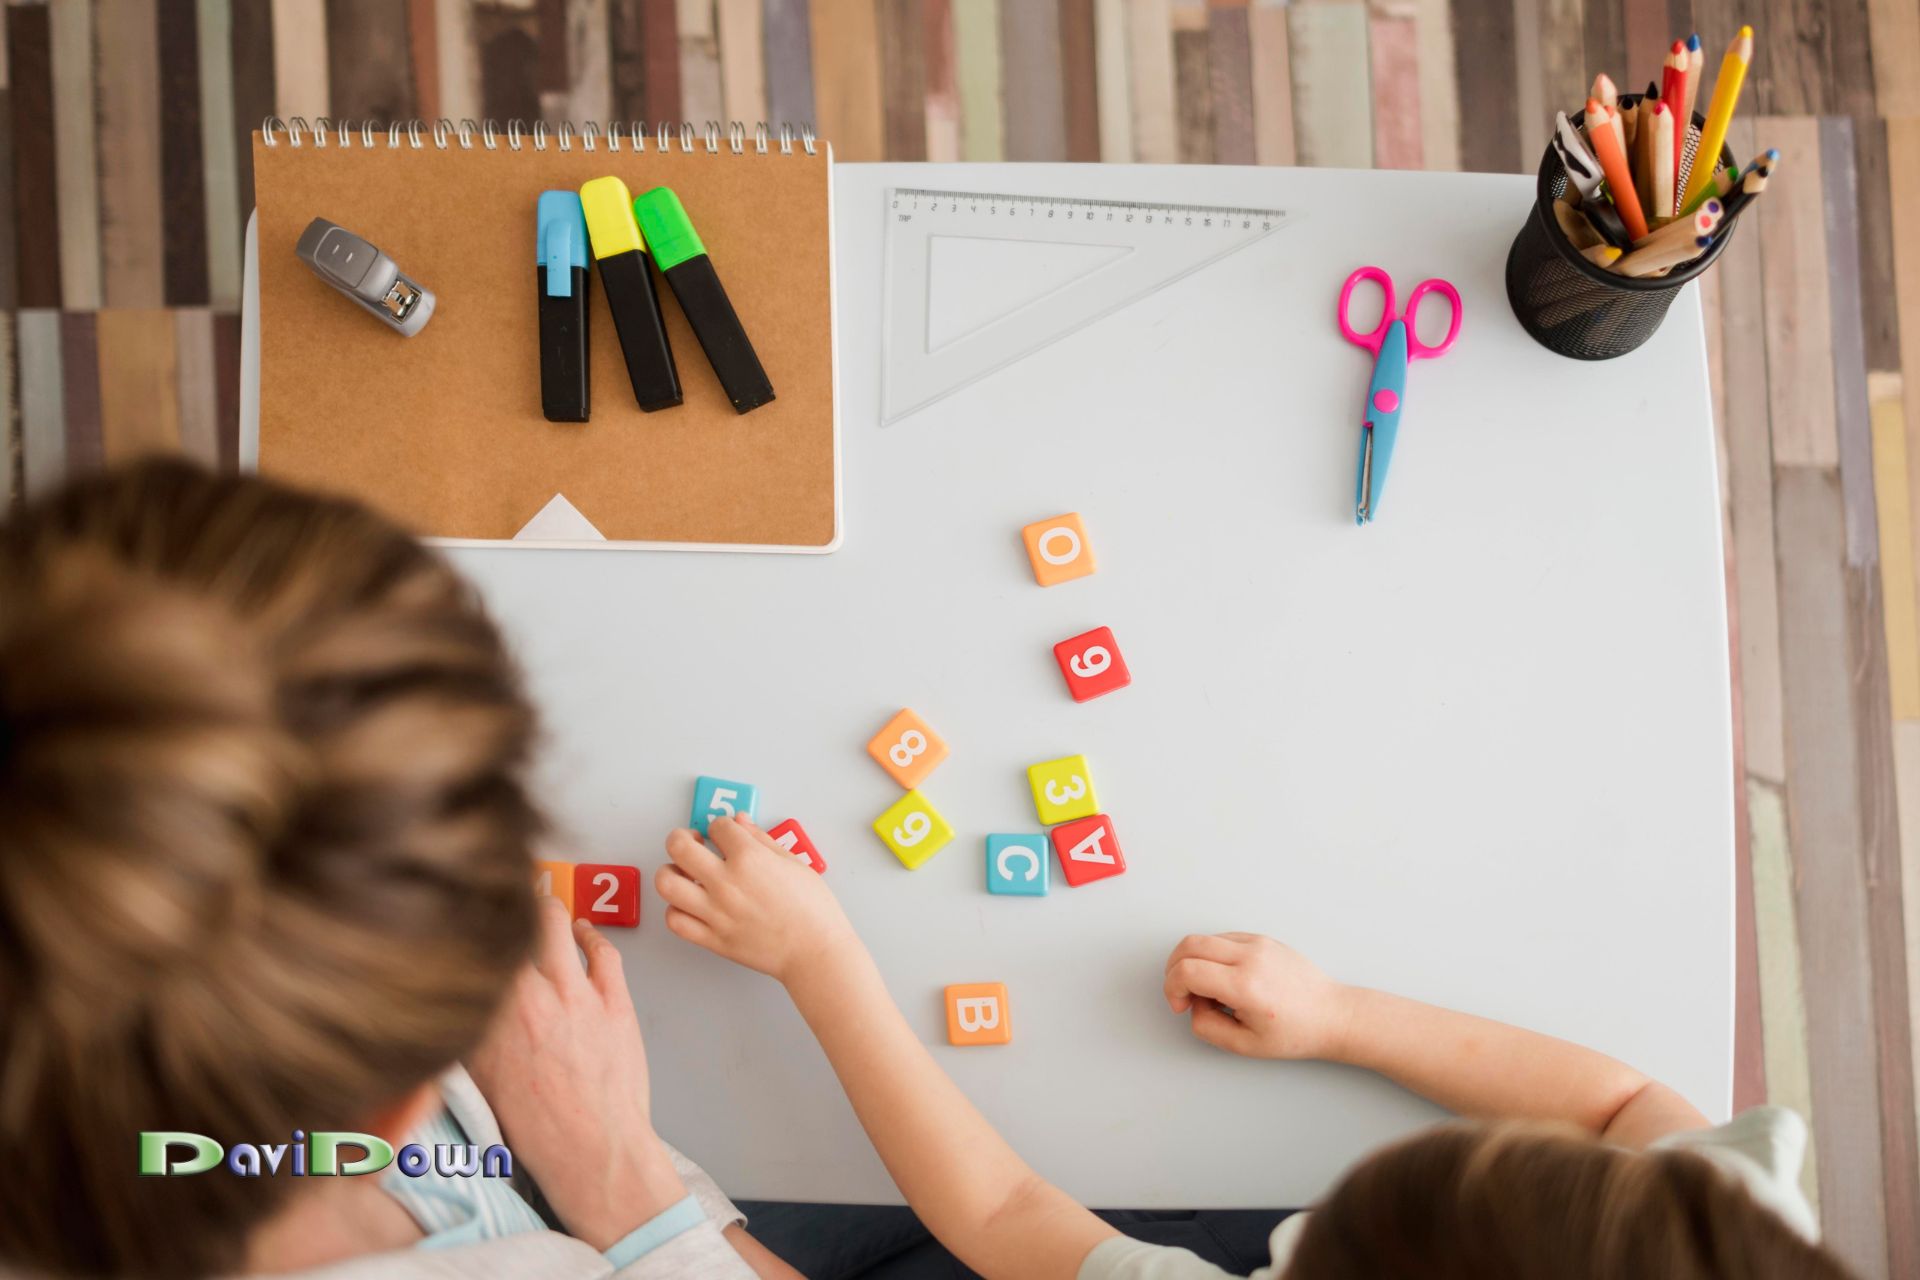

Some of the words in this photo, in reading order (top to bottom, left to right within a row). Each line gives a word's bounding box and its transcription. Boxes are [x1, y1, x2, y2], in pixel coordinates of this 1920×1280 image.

[890, 730, 927, 767] 8
[708, 788, 738, 823] 5
[1045, 775, 1086, 805] 3
[997, 845, 1040, 880] C
[1070, 827, 1115, 864] A
[592, 873, 619, 912] 2
[957, 997, 998, 1032] B
